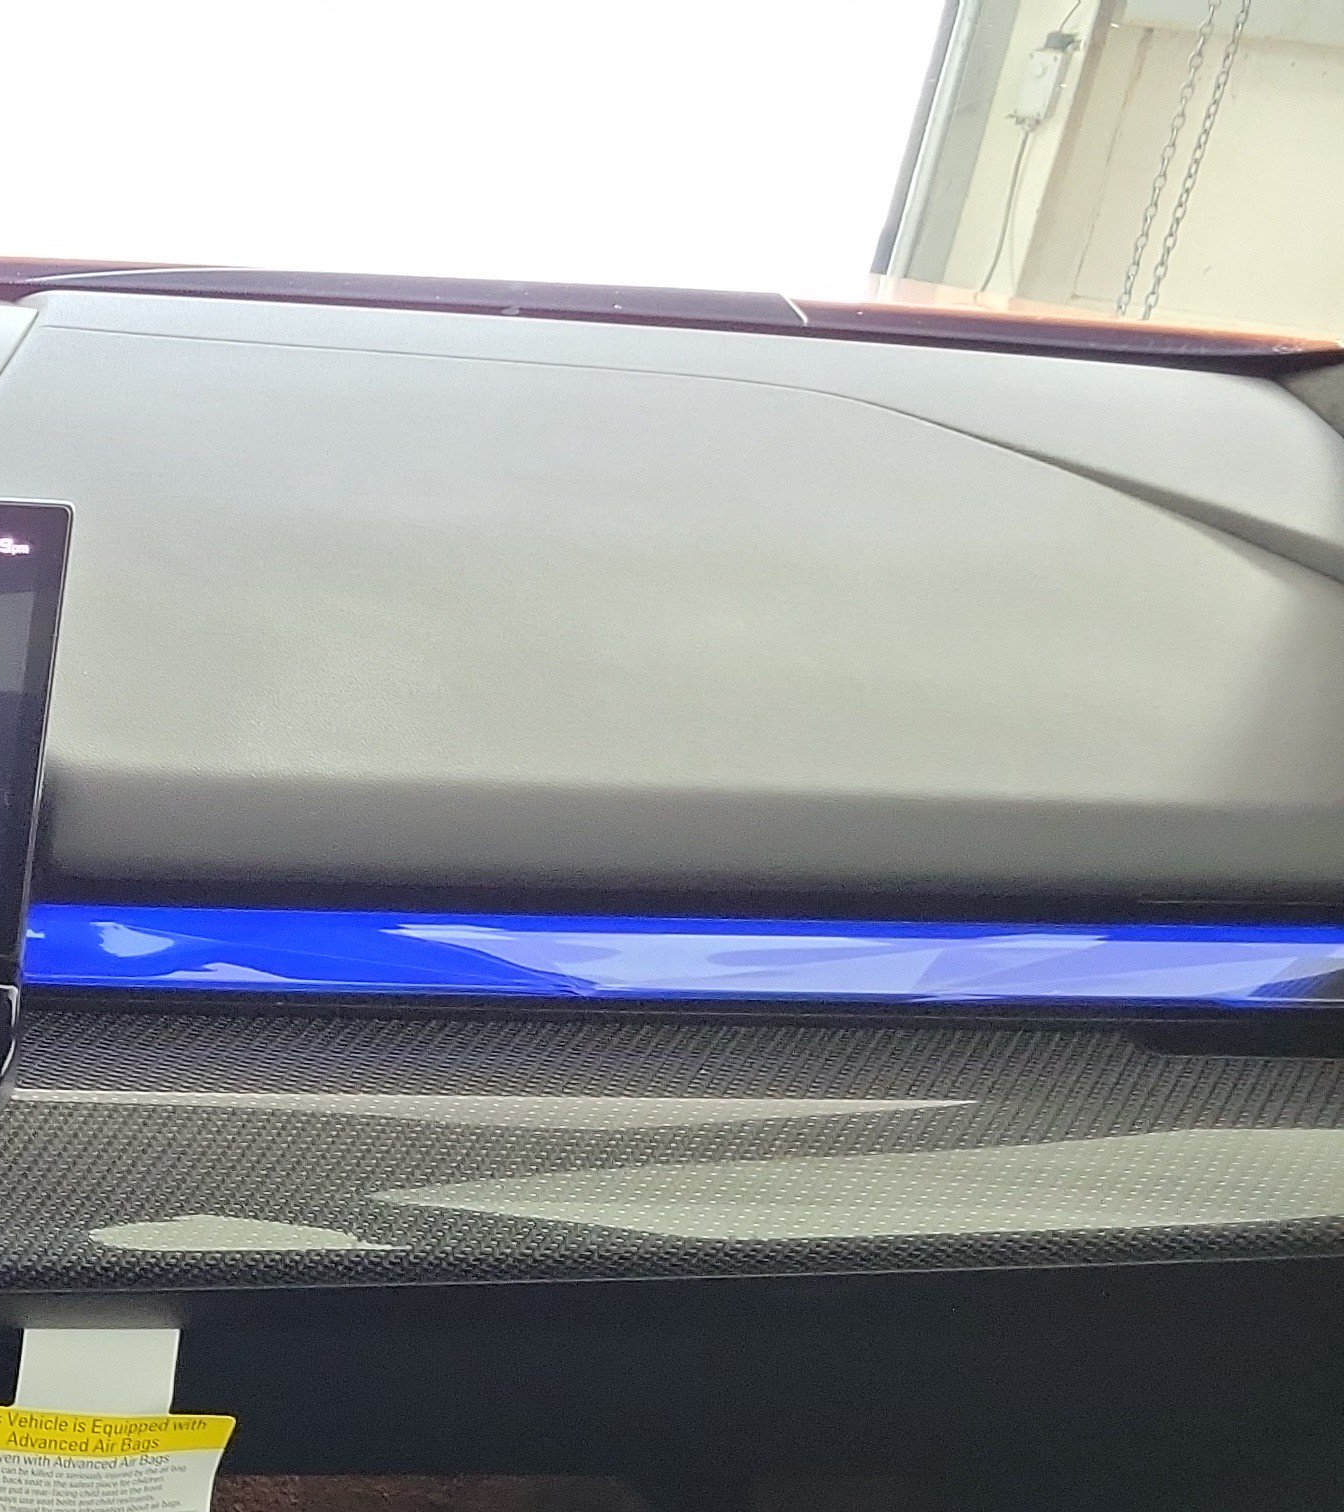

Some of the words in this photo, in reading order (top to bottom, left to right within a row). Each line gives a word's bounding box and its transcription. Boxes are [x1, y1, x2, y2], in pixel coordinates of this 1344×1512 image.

[7, 1413, 69, 1433] Vehicle
[73, 1417, 87, 1434] is
[91, 1418, 170, 1439] Equipped
[172, 1419, 208, 1432] with
[7, 1431, 90, 1453] Advanced
[92, 1435, 117, 1452] Air
[120, 1436, 160, 1455] Bags
[23, 1454, 51, 1467] with
[53, 1456, 118, 1469] Advanced
[120, 1456, 136, 1467] Air
[139, 1453, 170, 1467] Bags
